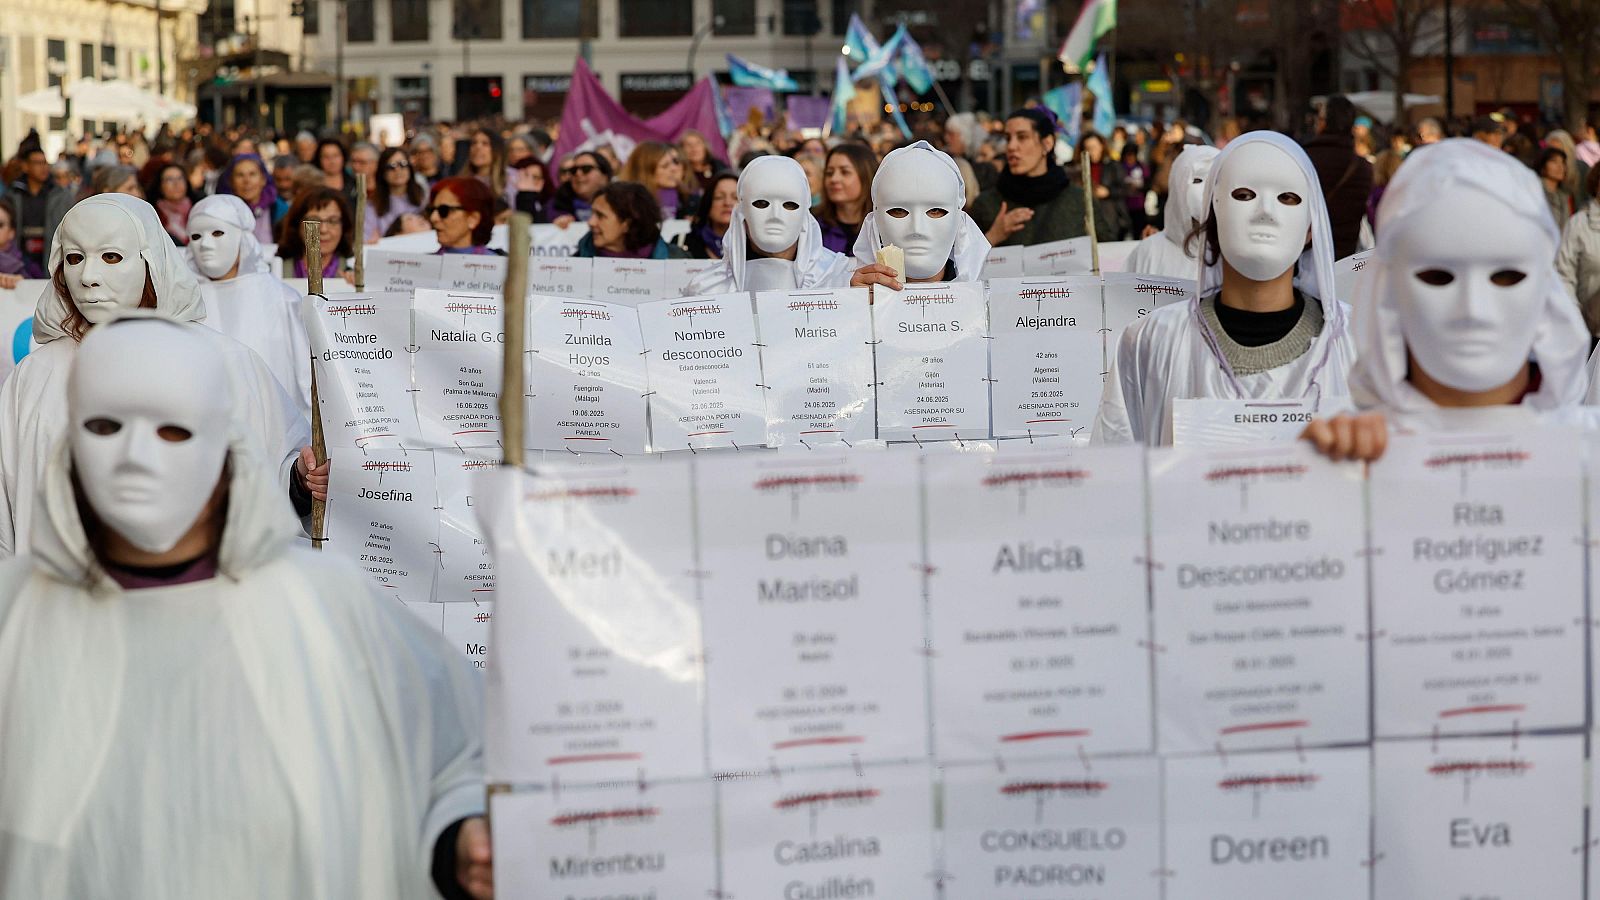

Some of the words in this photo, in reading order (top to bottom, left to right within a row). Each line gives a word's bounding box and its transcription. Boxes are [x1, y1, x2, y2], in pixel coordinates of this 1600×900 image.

[467, 280, 480, 289] del
[1137, 284, 1161, 293] SOMOS
[1165, 286, 1184, 296] ELLAS
[606, 286, 651, 296] Carmelina
[1021, 289, 1046, 299] SOMOS
[1049, 288, 1070, 298] ELLAS
[790, 302, 814, 311] SOMOS
[818, 300, 838, 310] ELLAS
[906, 295, 930, 305] SOMOS
[934, 294, 954, 304] ELLAS
[329, 305, 351, 315] SOMOS
[355, 304, 376, 314] ELLAS
[448, 303, 472, 313] SOMOS
[476, 304, 497, 315] ELLAS
[563, 309, 587, 318] SOMOS
[591, 310, 610, 320] ELLAS
[672, 307, 697, 317] SOMOS
[700, 305, 721, 315] ELLAS
[899, 321, 946, 333] Susana
[950, 321, 963, 332] S.
[1016, 315, 1076, 330] Alejandra
[334, 333, 377, 343] Nombre
[431, 330, 476, 342] Natalia
[675, 329, 725, 341] Nombre
[795, 327, 837, 338] Marisa
[565, 334, 612, 346] Zunilda
[323, 348, 393, 361] desconocido
[569, 353, 610, 367] Hoyos
[662, 347, 743, 361] desconocido
[695, 363, 729, 371] desconocida
[472, 389, 498, 398] Mallorca)
[691, 402, 724, 410] 23.06.2025
[345, 418, 380, 428] ASESINADA
[679, 415, 714, 423] ASESINADA
[1234, 414, 1277, 423] ENERO
[1282, 413, 1313, 422] 2026
[364, 460, 390, 471] SOMOS
[392, 461, 411, 472] ELLAS
[465, 460, 487, 470] SOMOS
[358, 487, 413, 502] Josefina
[1453, 502, 1503, 527] Rita
[1207, 518, 1312, 545] Nombre
[765, 532, 848, 562] Diana
[1413, 534, 1544, 564] Rodríguez
[360, 554, 393, 564] 27.06.2025
[991, 541, 1085, 575] Alicia
[1176, 556, 1345, 590] Desconocido
[1433, 567, 1526, 595] Gómez
[757, 574, 860, 604] Marisol
[466, 643, 486, 655] Me
[980, 827, 1127, 852] CONSUELO
[1449, 818, 1513, 849] Eva
[774, 836, 881, 867] Catalina
[1209, 833, 1330, 866] Doreen
[548, 850, 665, 880] Mirentxu
[994, 862, 1106, 888] PADRON
